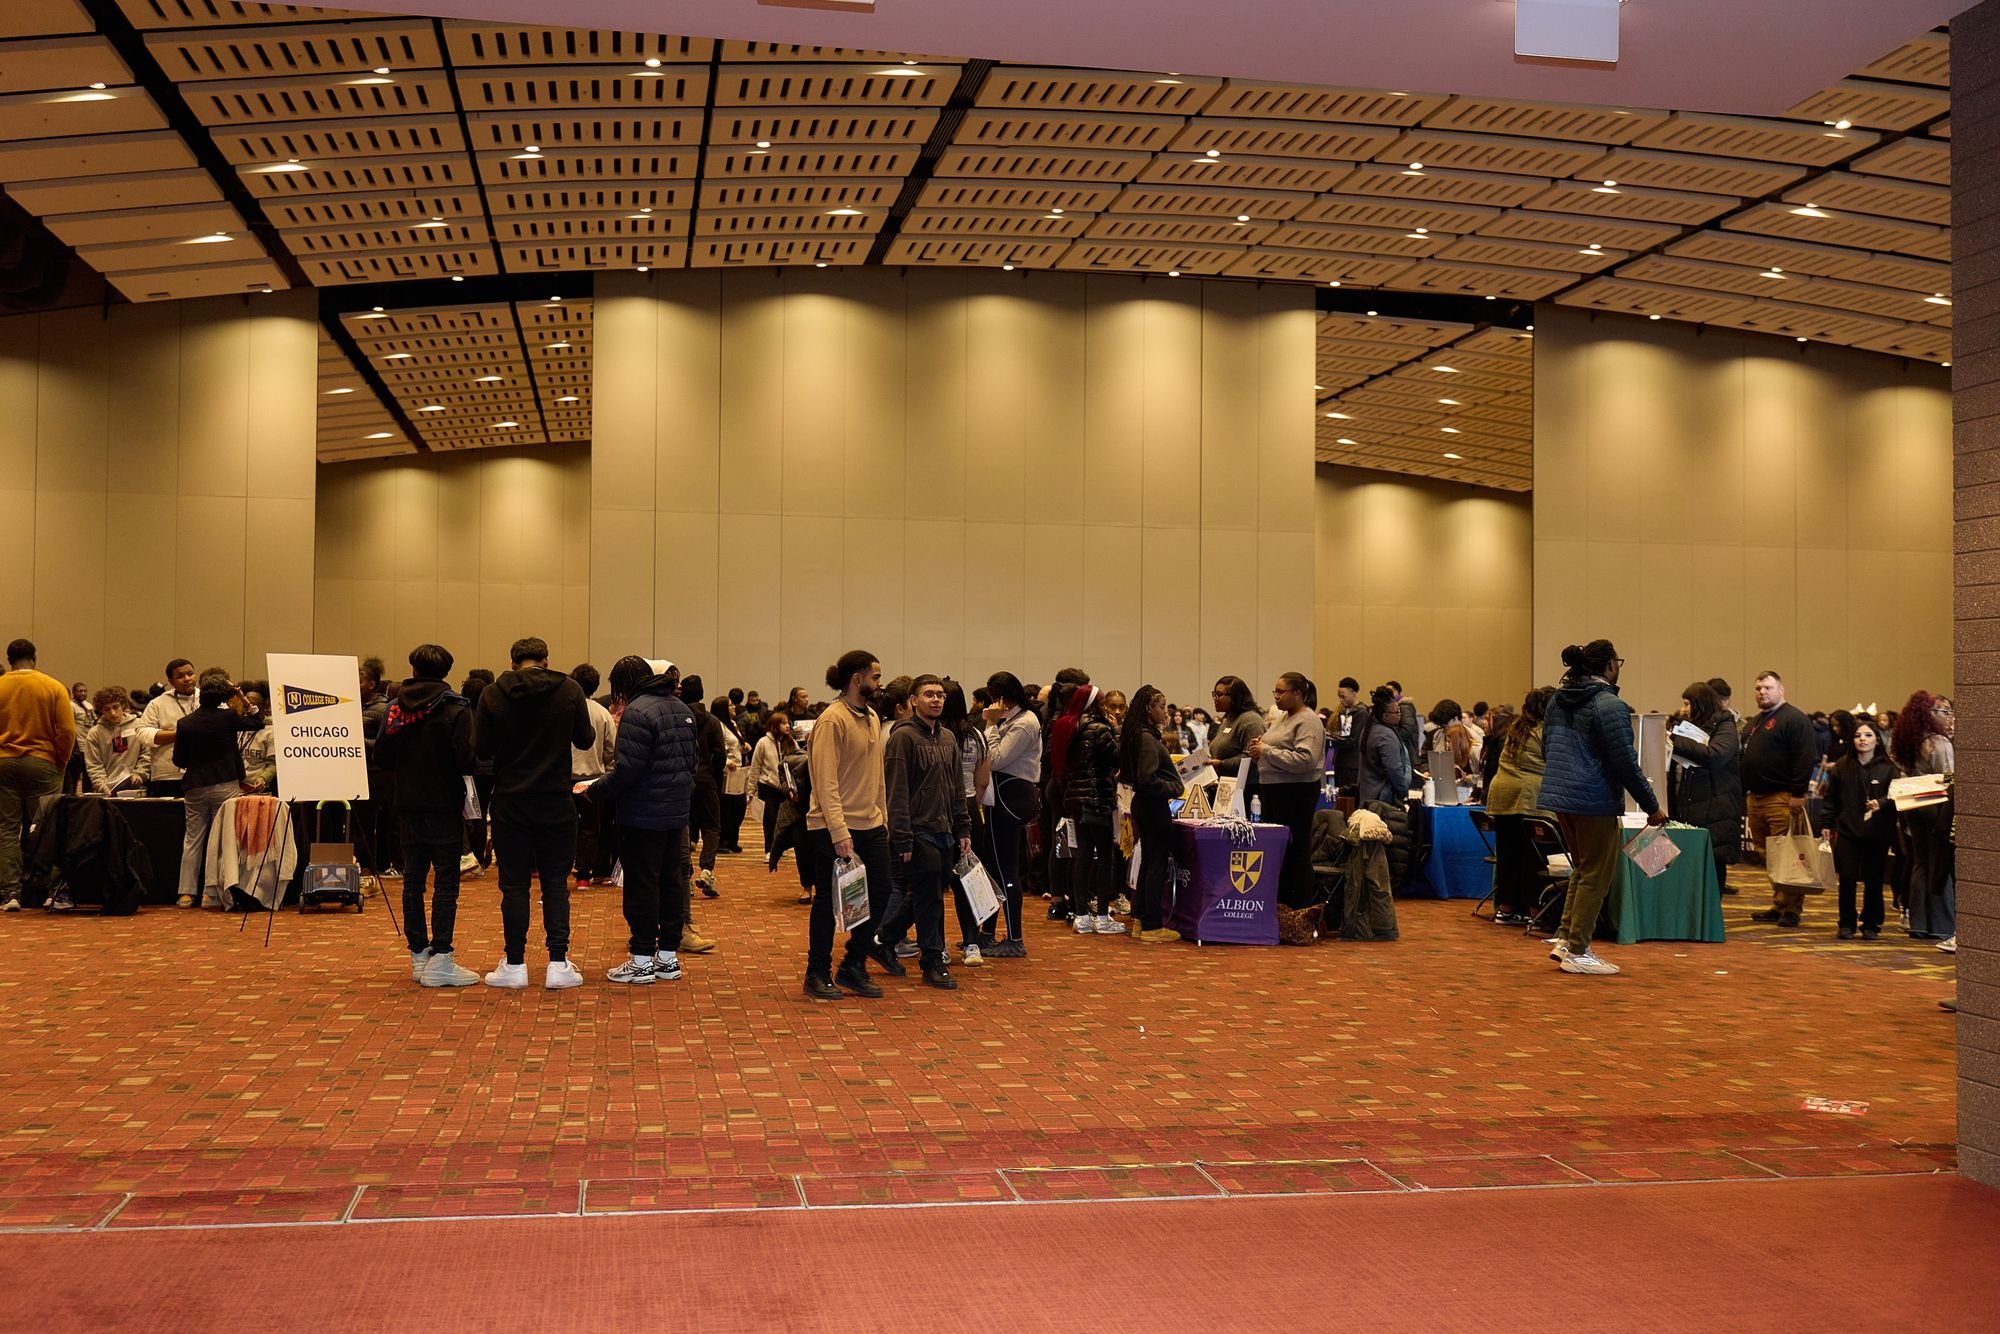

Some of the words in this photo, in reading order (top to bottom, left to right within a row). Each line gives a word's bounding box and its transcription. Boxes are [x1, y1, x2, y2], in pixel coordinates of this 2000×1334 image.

[303, 694, 325, 706] COLLEGE
[325, 696, 336, 705] FAIR
[290, 726, 349, 738] CHICAGO
[283, 746, 362, 759] CONCOURSE
[1179, 784, 1215, 818] A
[1215, 898, 1265, 912] ALBION
[1223, 911, 1255, 920] COLLEGE
